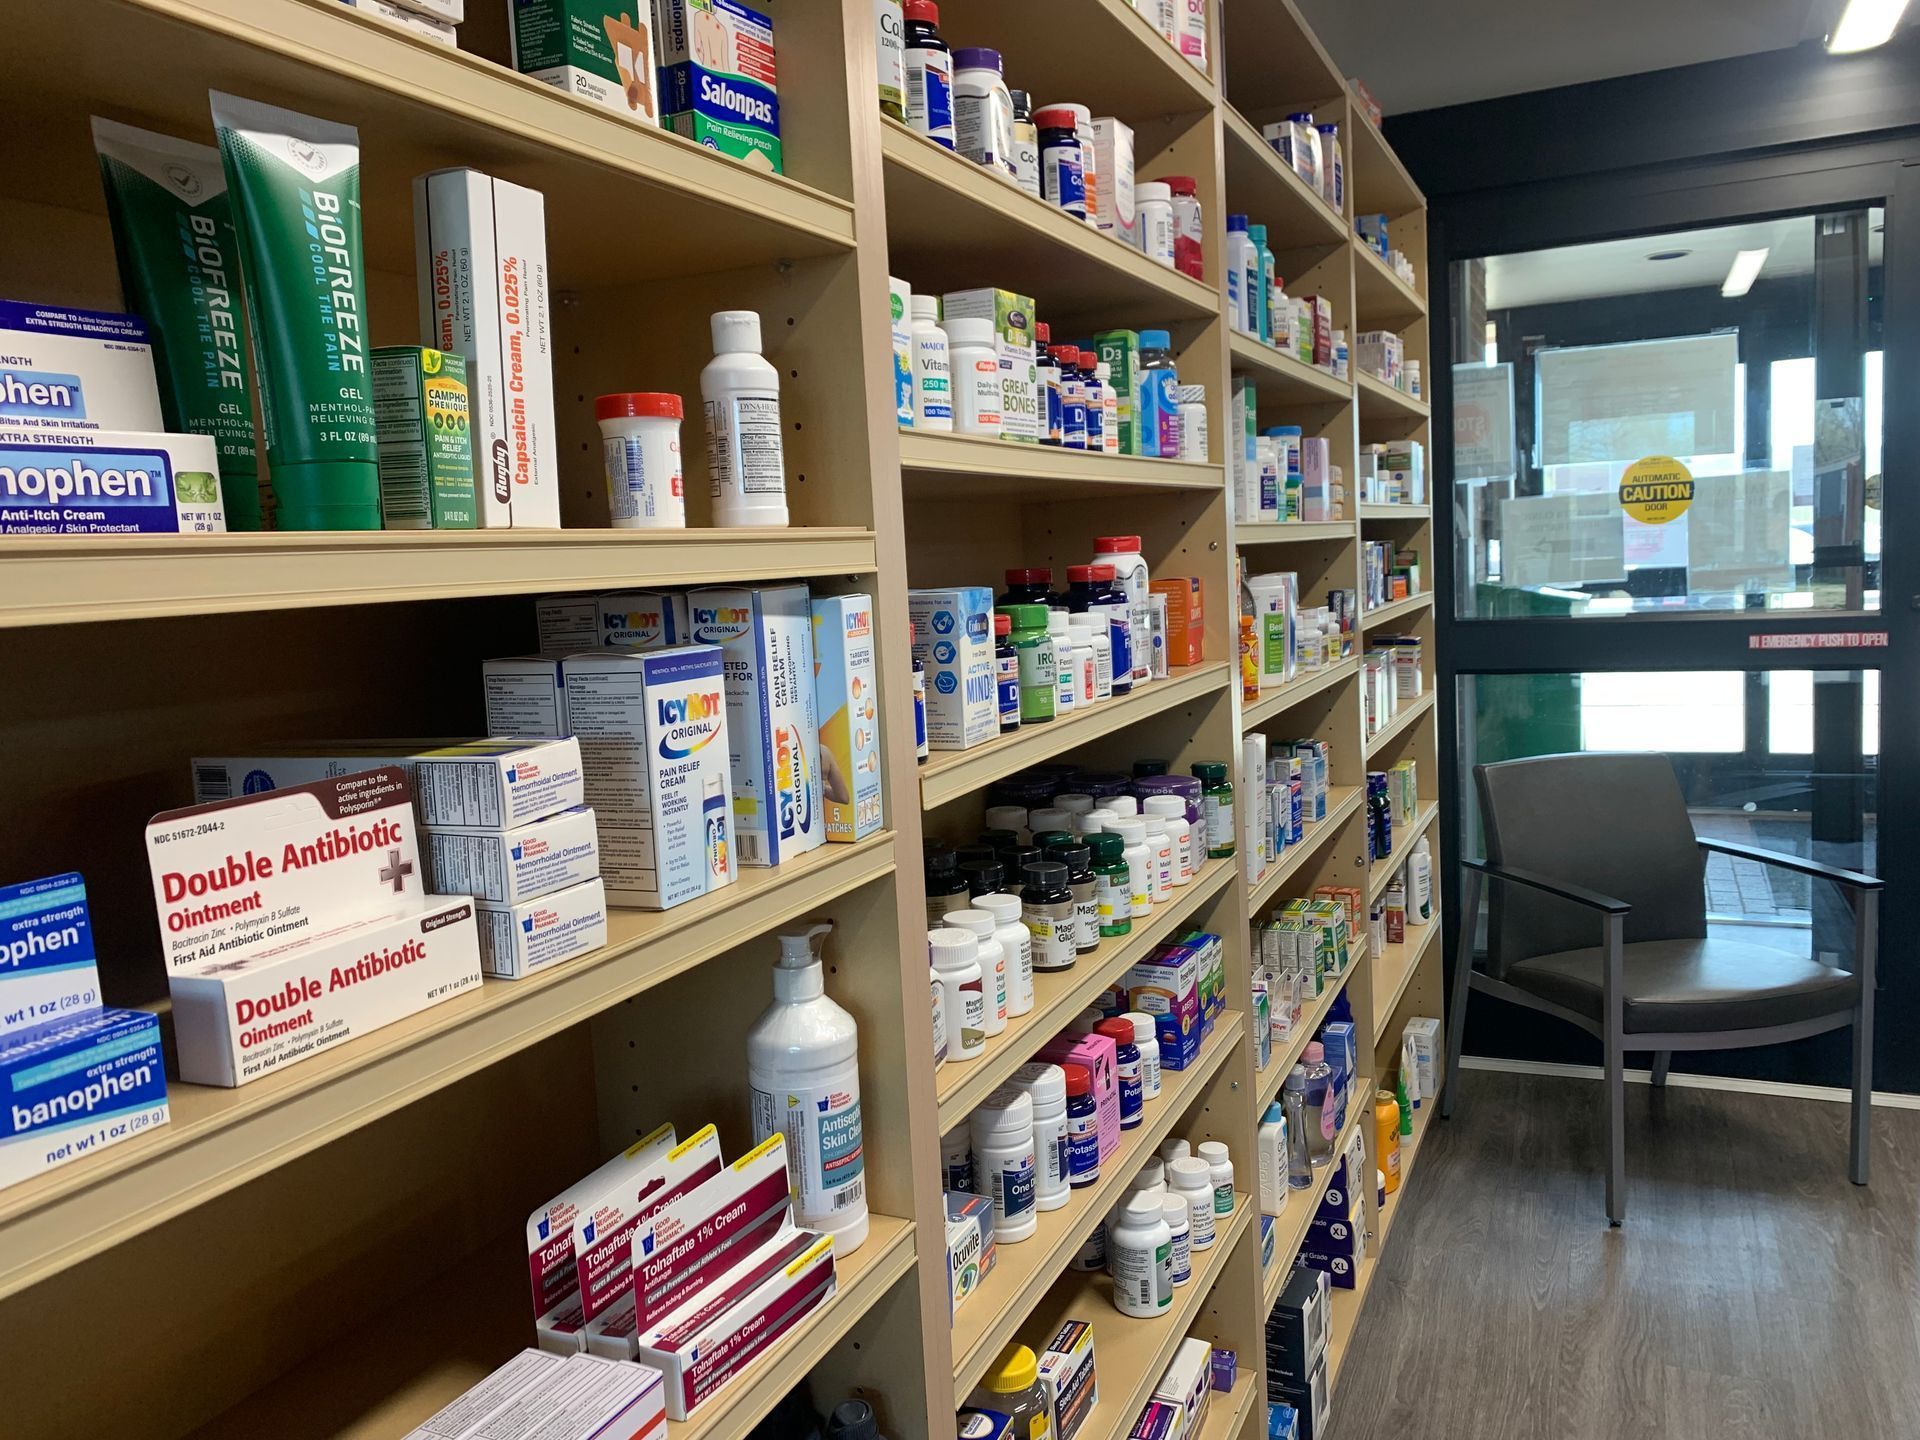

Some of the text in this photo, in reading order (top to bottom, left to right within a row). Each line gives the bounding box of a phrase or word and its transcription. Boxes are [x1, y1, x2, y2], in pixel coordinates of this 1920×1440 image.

[575, 75, 586, 87] 20
[706, 122, 772, 150] Pain Relieving Patch
[537, 264, 542, 273] g)
[313, 190, 364, 375] BIOFREEZE
[189, 215, 243, 391] BIOFREEZE
[538, 290, 544, 302] OZ
[309, 243, 340, 372] COOL THE PAIN
[186, 264, 219, 388] COOL THE PAIN
[539, 320, 545, 334] WT
[920, 342, 944, 351] MAJOR
[1103, 347, 1122, 361] D3
[503, 257, 530, 484] Capsaicin Cream, 0.025%
[339, 387, 364, 400] GEL
[1002, 378, 1028, 395] GREAT
[429, 389, 466, 403] CAMPHO
[1003, 395, 1035, 414] BONES
[218, 404, 242, 415] GEL
[429, 400, 467, 412] PHENIQUE
[0, 417, 20, 425] Bites
[41, 419, 59, 427] Skin
[61, 420, 99, 429] Irritations
[310, 414, 368, 426] RELIEVING
[33, 434, 93, 445] STRENGTH
[320, 432, 357, 442] 3 FL OZ
[435, 434, 449, 443] PAIN
[454, 437, 467, 445] ITCH
[442, 443, 461, 452] RELIEF
[494, 446, 509, 496] Rugby
[1632, 473, 1680, 483] AUTOMATIC
[1623, 484, 1690, 501] CAUTION
[1, 509, 105, 521] Anti-Itch Cream
[1645, 503, 1667, 511] DOOR
[181, 513, 194, 521] NET
[195, 513, 207, 521] WT
[213, 513, 221, 521] OZ
[6, 523, 57, 533] Analgesic
[66, 523, 88, 533] Skin
[90, 524, 139, 532] Protectant
[195, 523, 213, 533] (28 g)
[604, 612, 659, 629] ICYHOT
[694, 608, 749, 624] ICYHOT
[845, 611, 870, 630] ICYHOT
[614, 631, 650, 639] ORIGINAL
[1749, 632, 1888, 648] IN EMERGENCY PUSH TO OPEN
[770, 628, 778, 671] RELIEF
[968, 661, 990, 674] ACTIVE
[779, 659, 787, 706] CREAM
[966, 679, 989, 706] MIND
[658, 693, 720, 726] ICYHOT
[671, 722, 712, 740] ORIGINAL
[660, 761, 700, 779] PAIN RELIEF
[791, 742, 802, 815] ORIGINAL
[336, 780, 366, 793] Compare
[377, 774, 388, 783] the
[511, 769, 577, 793] Hemorrhoidal Ointment
[660, 775, 686, 789] CREAM
[775, 726, 795, 841] ICYHOT
[338, 782, 403, 803] active ingredients in
[661, 793, 673, 801] FEEL
[662, 796, 687, 808] WORKING
[663, 804, 688, 816] INSTANTLY
[834, 808, 840, 821] 5
[154, 822, 225, 845] NDC 51672-2044-2
[162, 850, 273, 904] Double
[281, 818, 402, 873] Antibiotic
[515, 843, 591, 871] Hemorrhoidal Ointment
[12, 905, 84, 932] extra strength
[168, 891, 262, 932] Ointment
[425, 909, 467, 930] Original Strength
[527, 911, 600, 942] Hemorrhoidal Ointment
[173, 917, 309, 966] First Aid Antibiotic Ointment
[235, 976, 322, 1025] Double
[329, 939, 427, 992] Antibiotic
[427, 986, 438, 1000] NET
[439, 985, 448, 995] WT
[454, 981, 460, 989] oz
[460, 975, 472, 988] (28.4
[473, 973, 480, 985] g)
[239, 1008, 313, 1049] Ointment
[243, 1026, 350, 1076] First Aid Antibiotic Ointment
[86, 1047, 156, 1079] extra strength
[46, 1108, 164, 1164] net wt 1 oz (28 g)
[823, 1132, 847, 1150] Skin
[1011, 1183, 1029, 1195] One
[1330, 1193, 1338, 1202] S
[643, 1202, 747, 1281] Tolnaftate 1% Cream
[1332, 1227, 1346, 1238] XL
[586, 1229, 635, 1269] Tolnaftate
[953, 1232, 979, 1269] Ocuvite
[1309, 1253, 1328, 1261] Grade
[1334, 1261, 1347, 1272] XL
[644, 1269, 672, 1292] Antifungal
[692, 1315, 765, 1377] Tolnaftate 1% Cream
